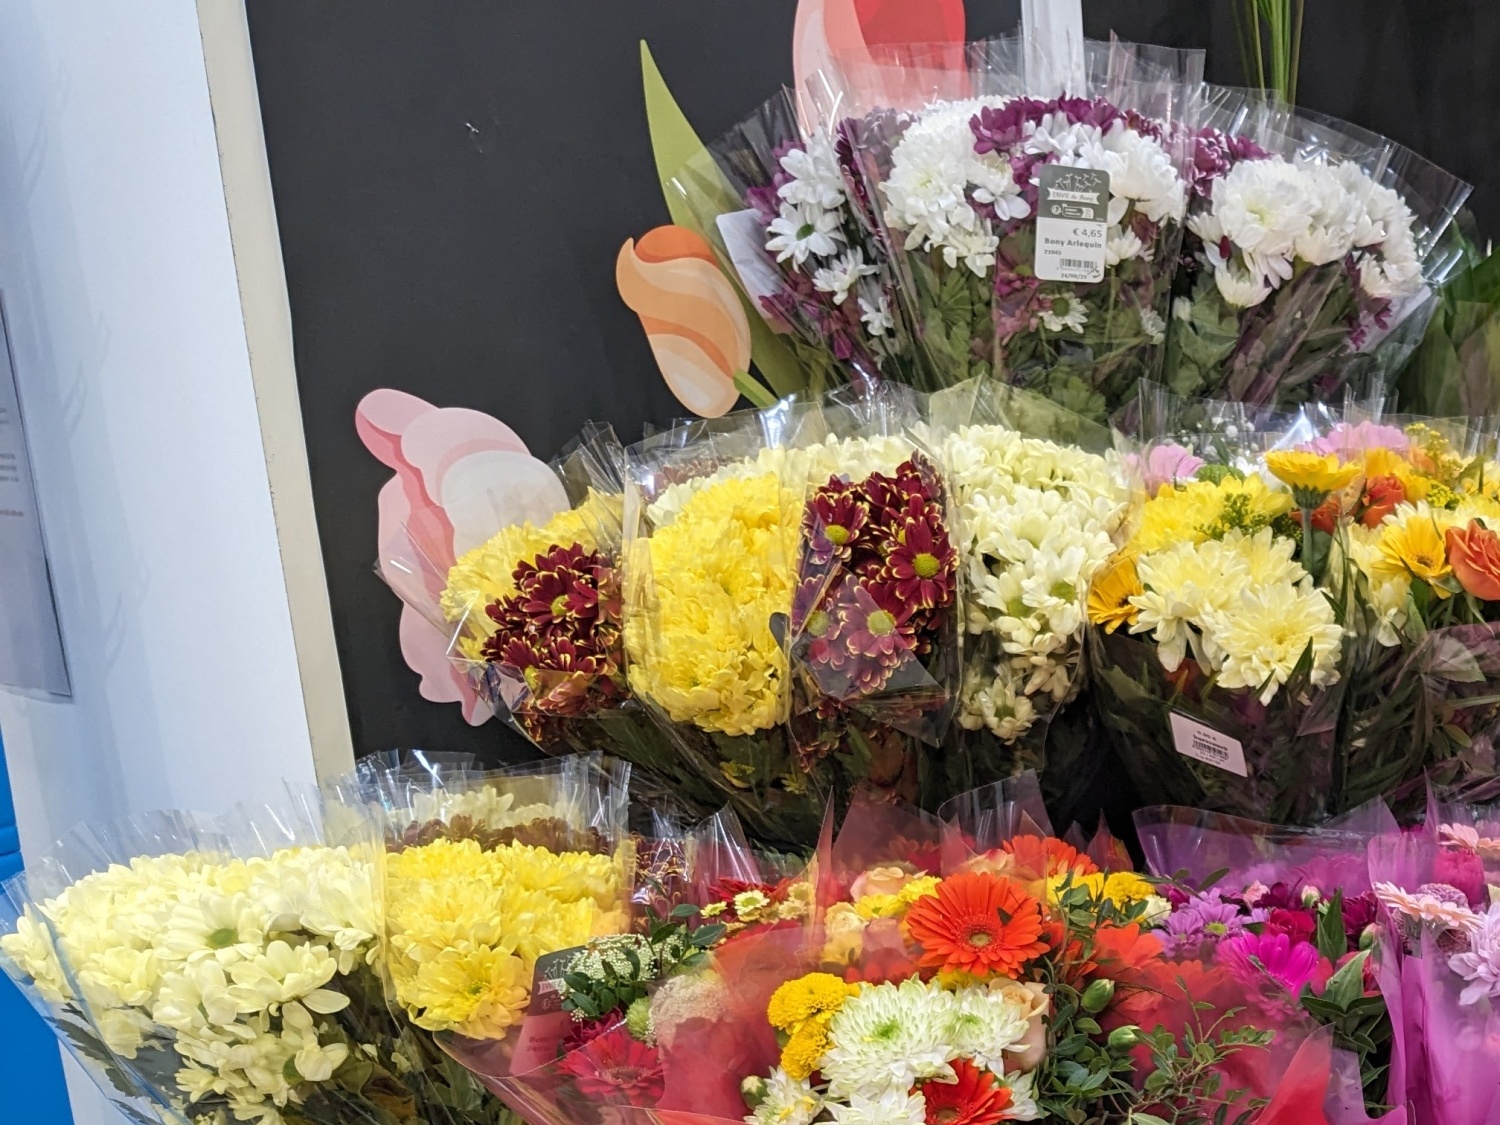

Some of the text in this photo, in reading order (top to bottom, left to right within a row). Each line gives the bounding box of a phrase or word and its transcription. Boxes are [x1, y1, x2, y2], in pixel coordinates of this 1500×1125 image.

[1081, 229, 1103, 238] 4,65
[1044, 237, 1102, 249] Bony Arlequin
